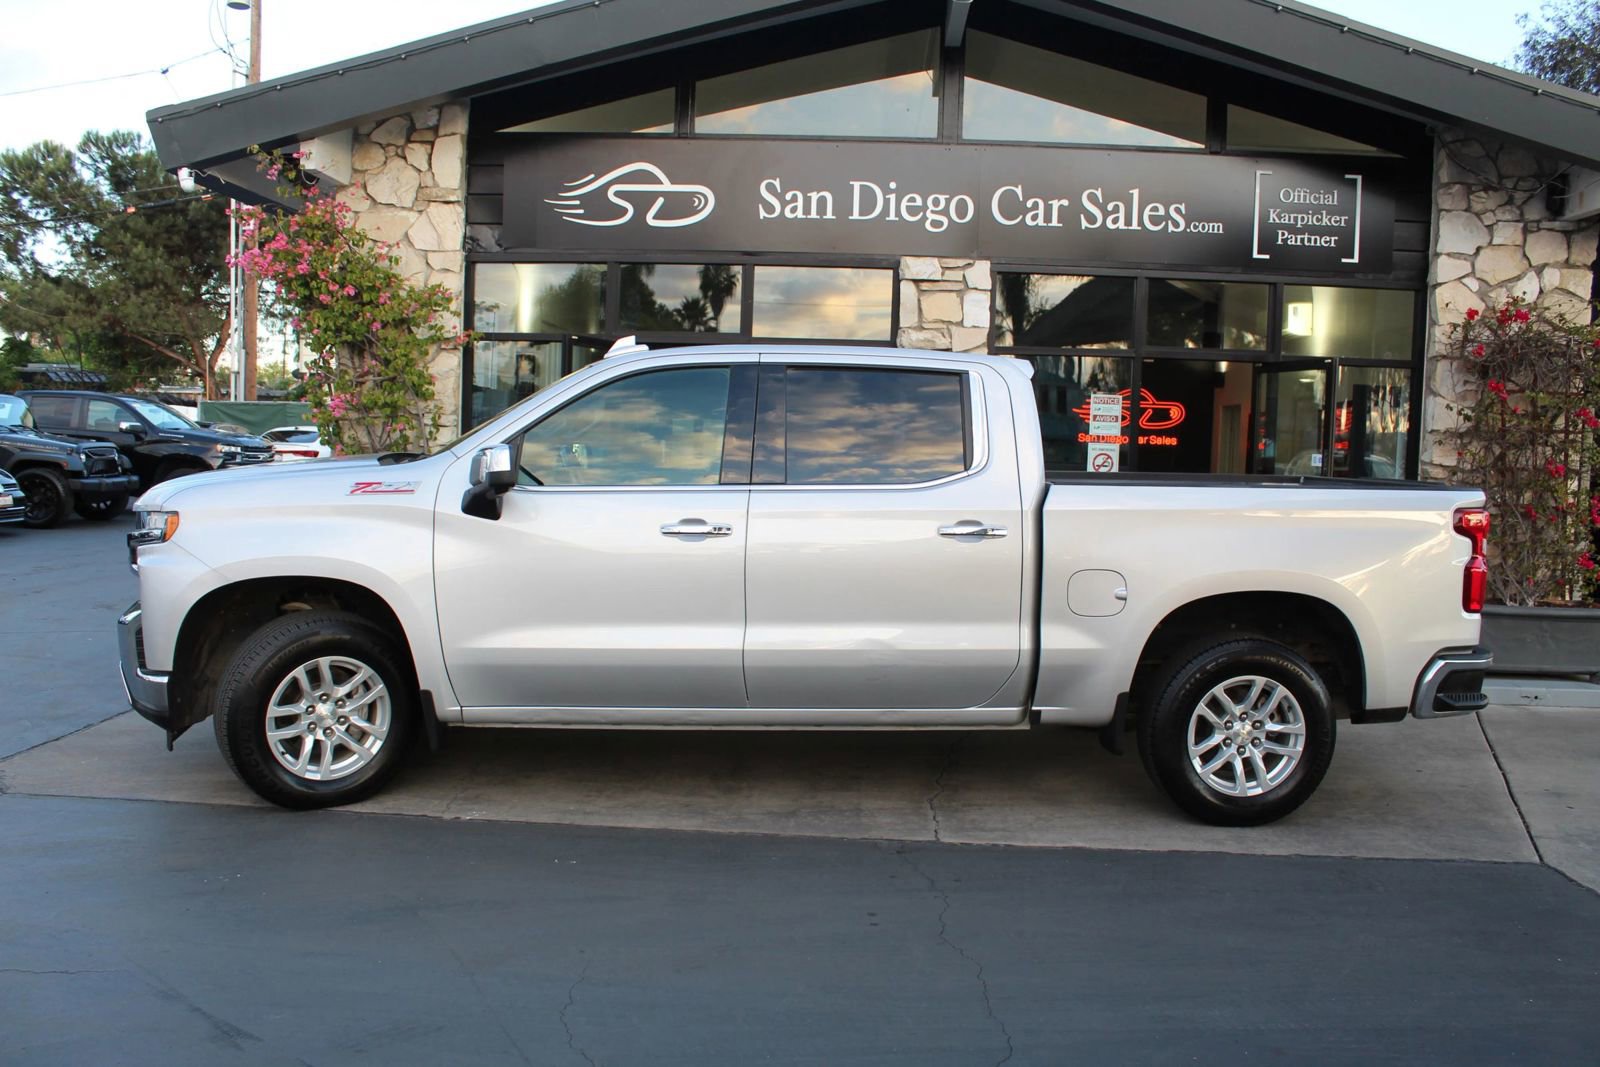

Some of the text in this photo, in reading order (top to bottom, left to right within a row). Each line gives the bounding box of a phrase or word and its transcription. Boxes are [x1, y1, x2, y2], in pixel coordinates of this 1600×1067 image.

[758, 177, 836, 219] San
[848, 181, 975, 233] Diego
[990, 185, 1070, 227] Car
[1279, 188, 1338, 205] Official
[1268, 208, 1348, 227] Karpicker
[1276, 230, 1338, 247] Partner
[1078, 433, 1098, 443] San
[1099, 434, 1129, 445] Diego
[1149, 435, 1178, 446] Sales
